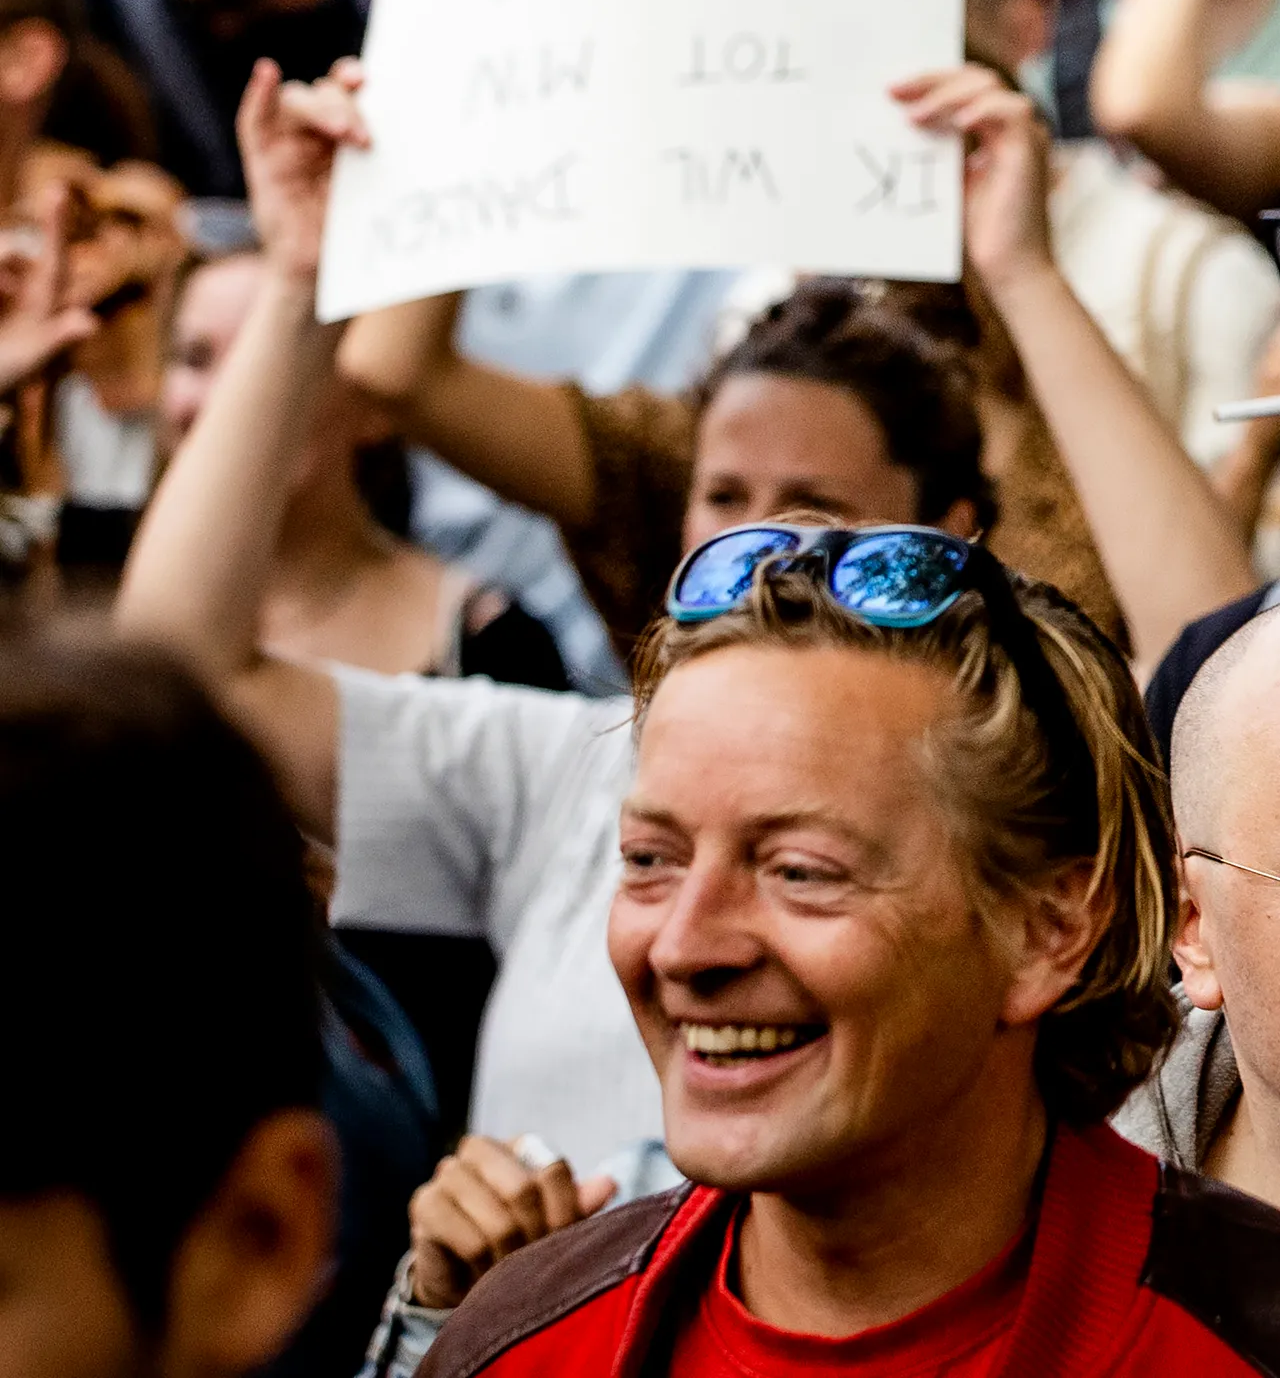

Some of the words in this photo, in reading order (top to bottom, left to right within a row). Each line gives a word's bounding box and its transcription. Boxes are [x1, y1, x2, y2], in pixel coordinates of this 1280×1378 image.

[677, 31, 810, 88] TOT
[661, 144, 782, 208] WIL
[854, 142, 941, 218] IK
